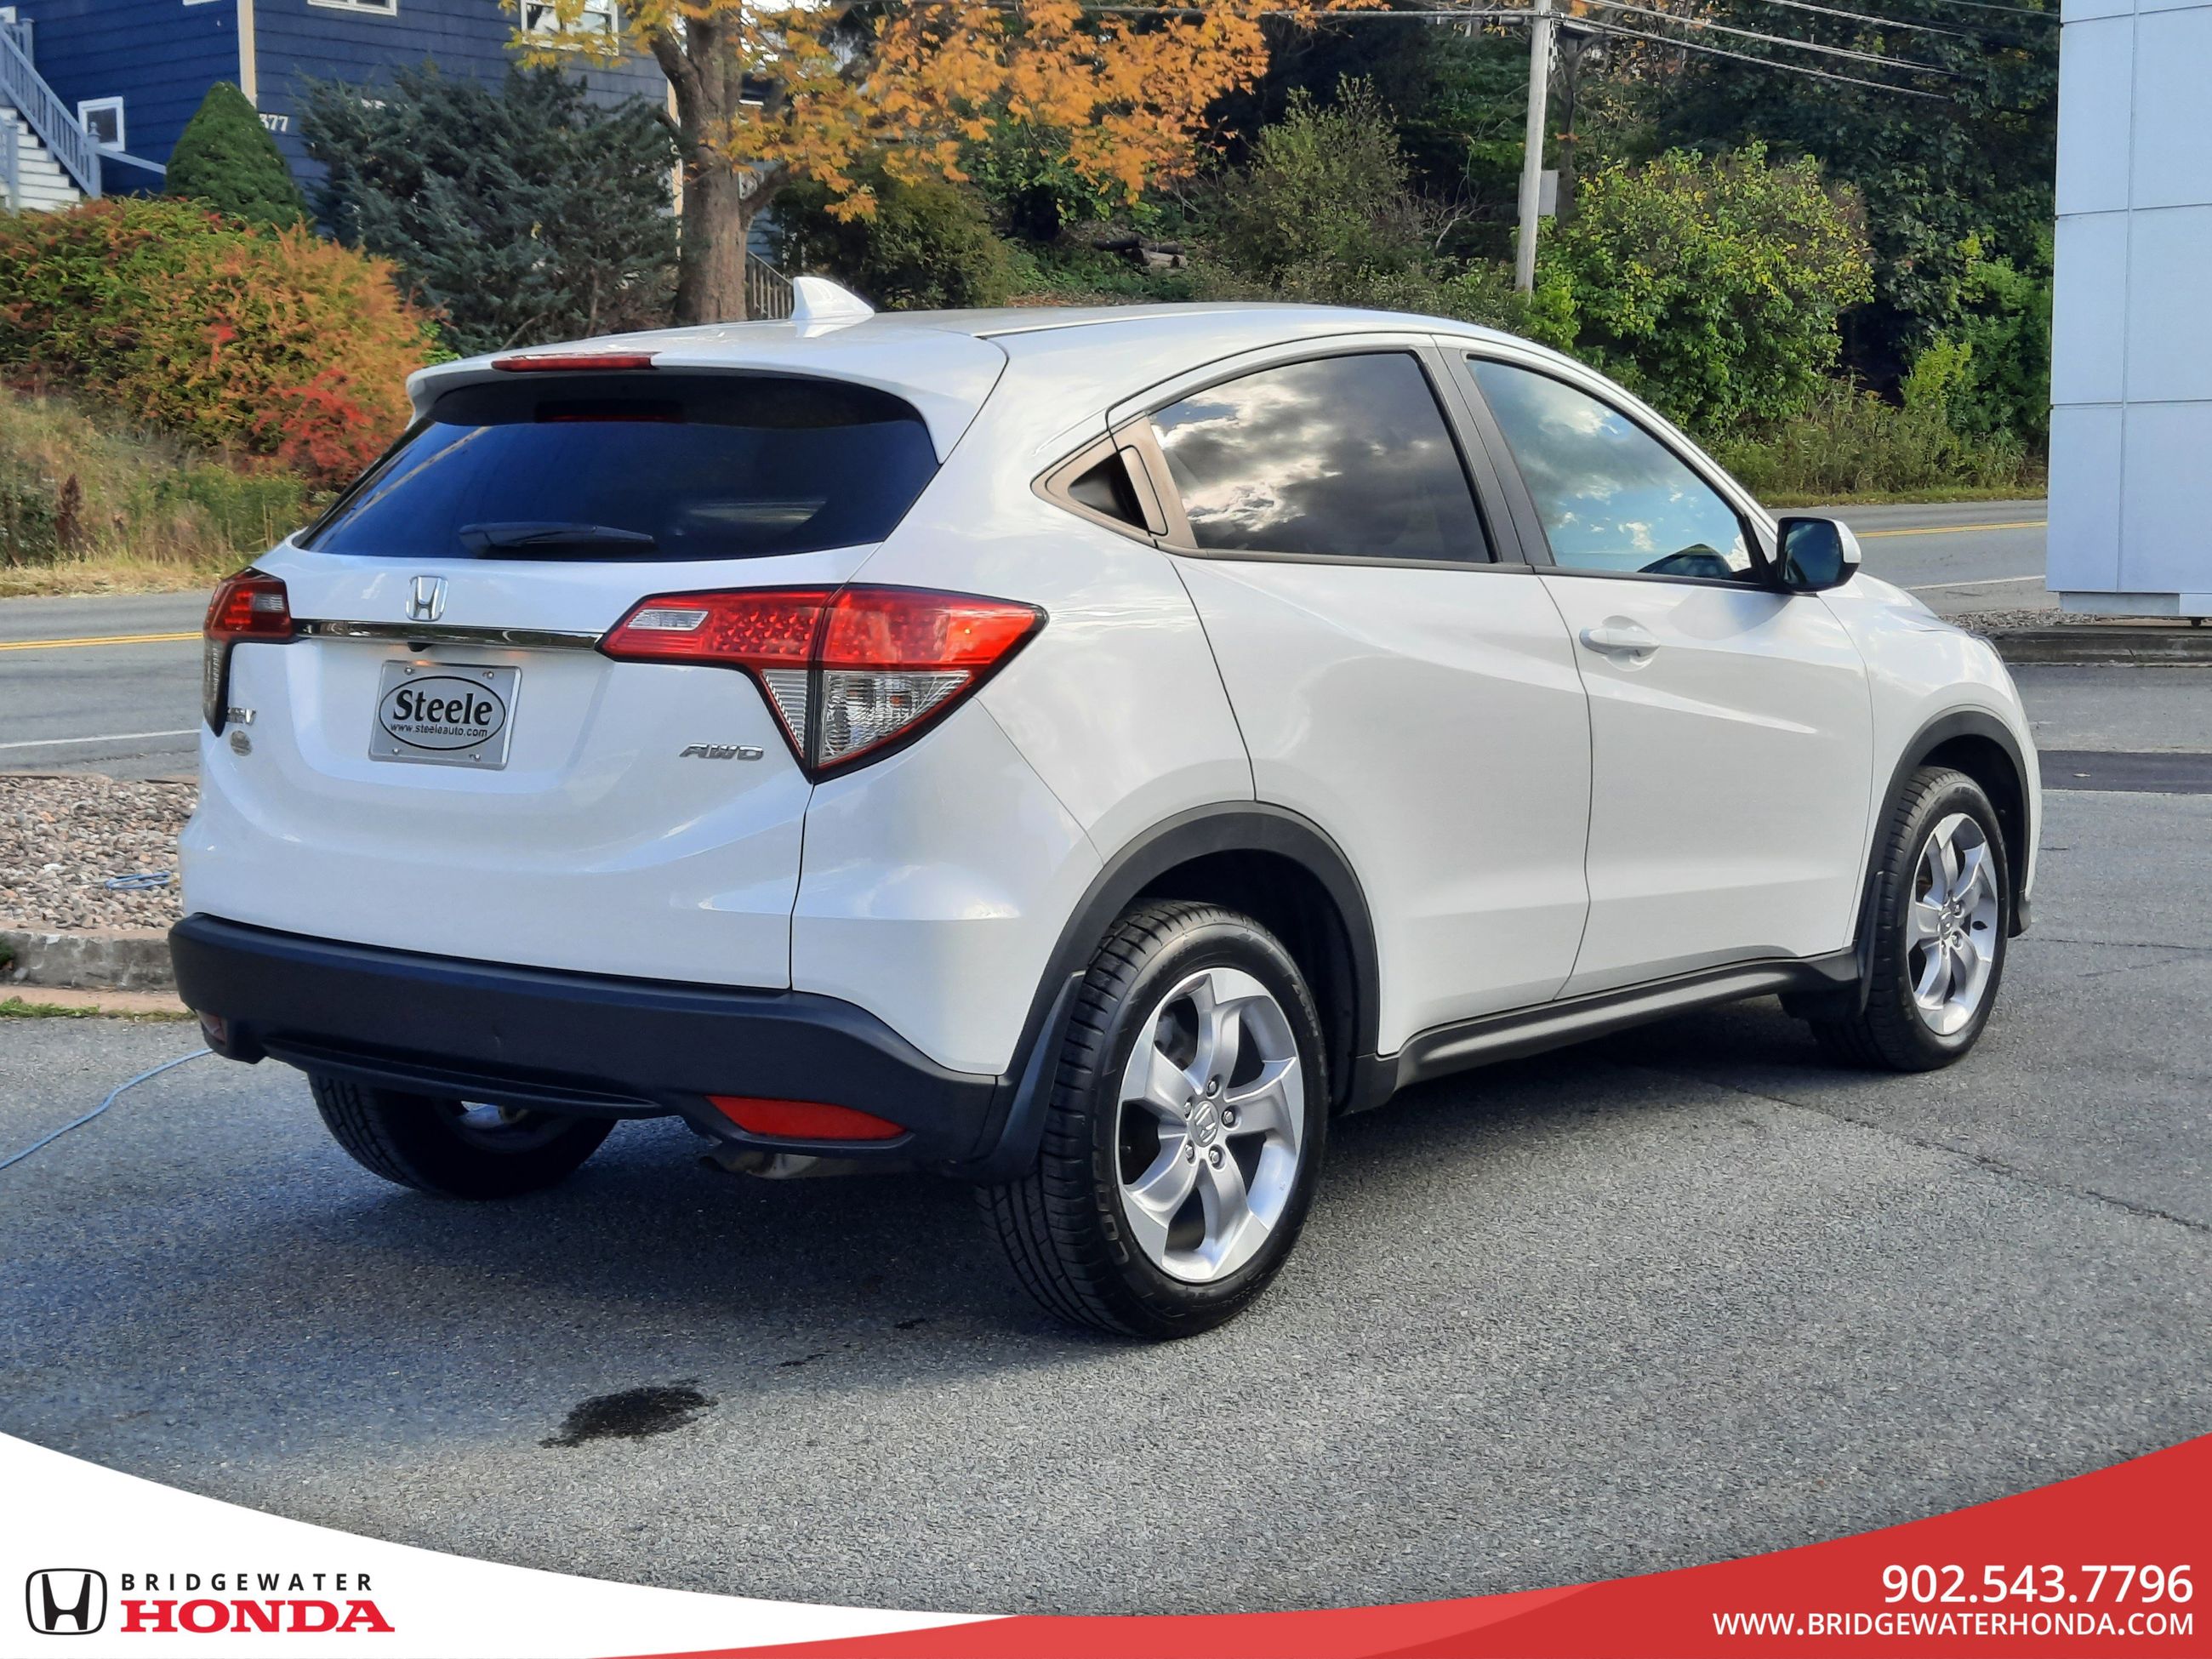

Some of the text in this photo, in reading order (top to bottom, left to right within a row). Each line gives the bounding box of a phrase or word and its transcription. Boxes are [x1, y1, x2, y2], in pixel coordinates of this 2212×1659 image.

[393, 689, 493, 726] Steele
[391, 722, 488, 738] www.steeleauto.com
[679, 743, 764, 761] AWD
